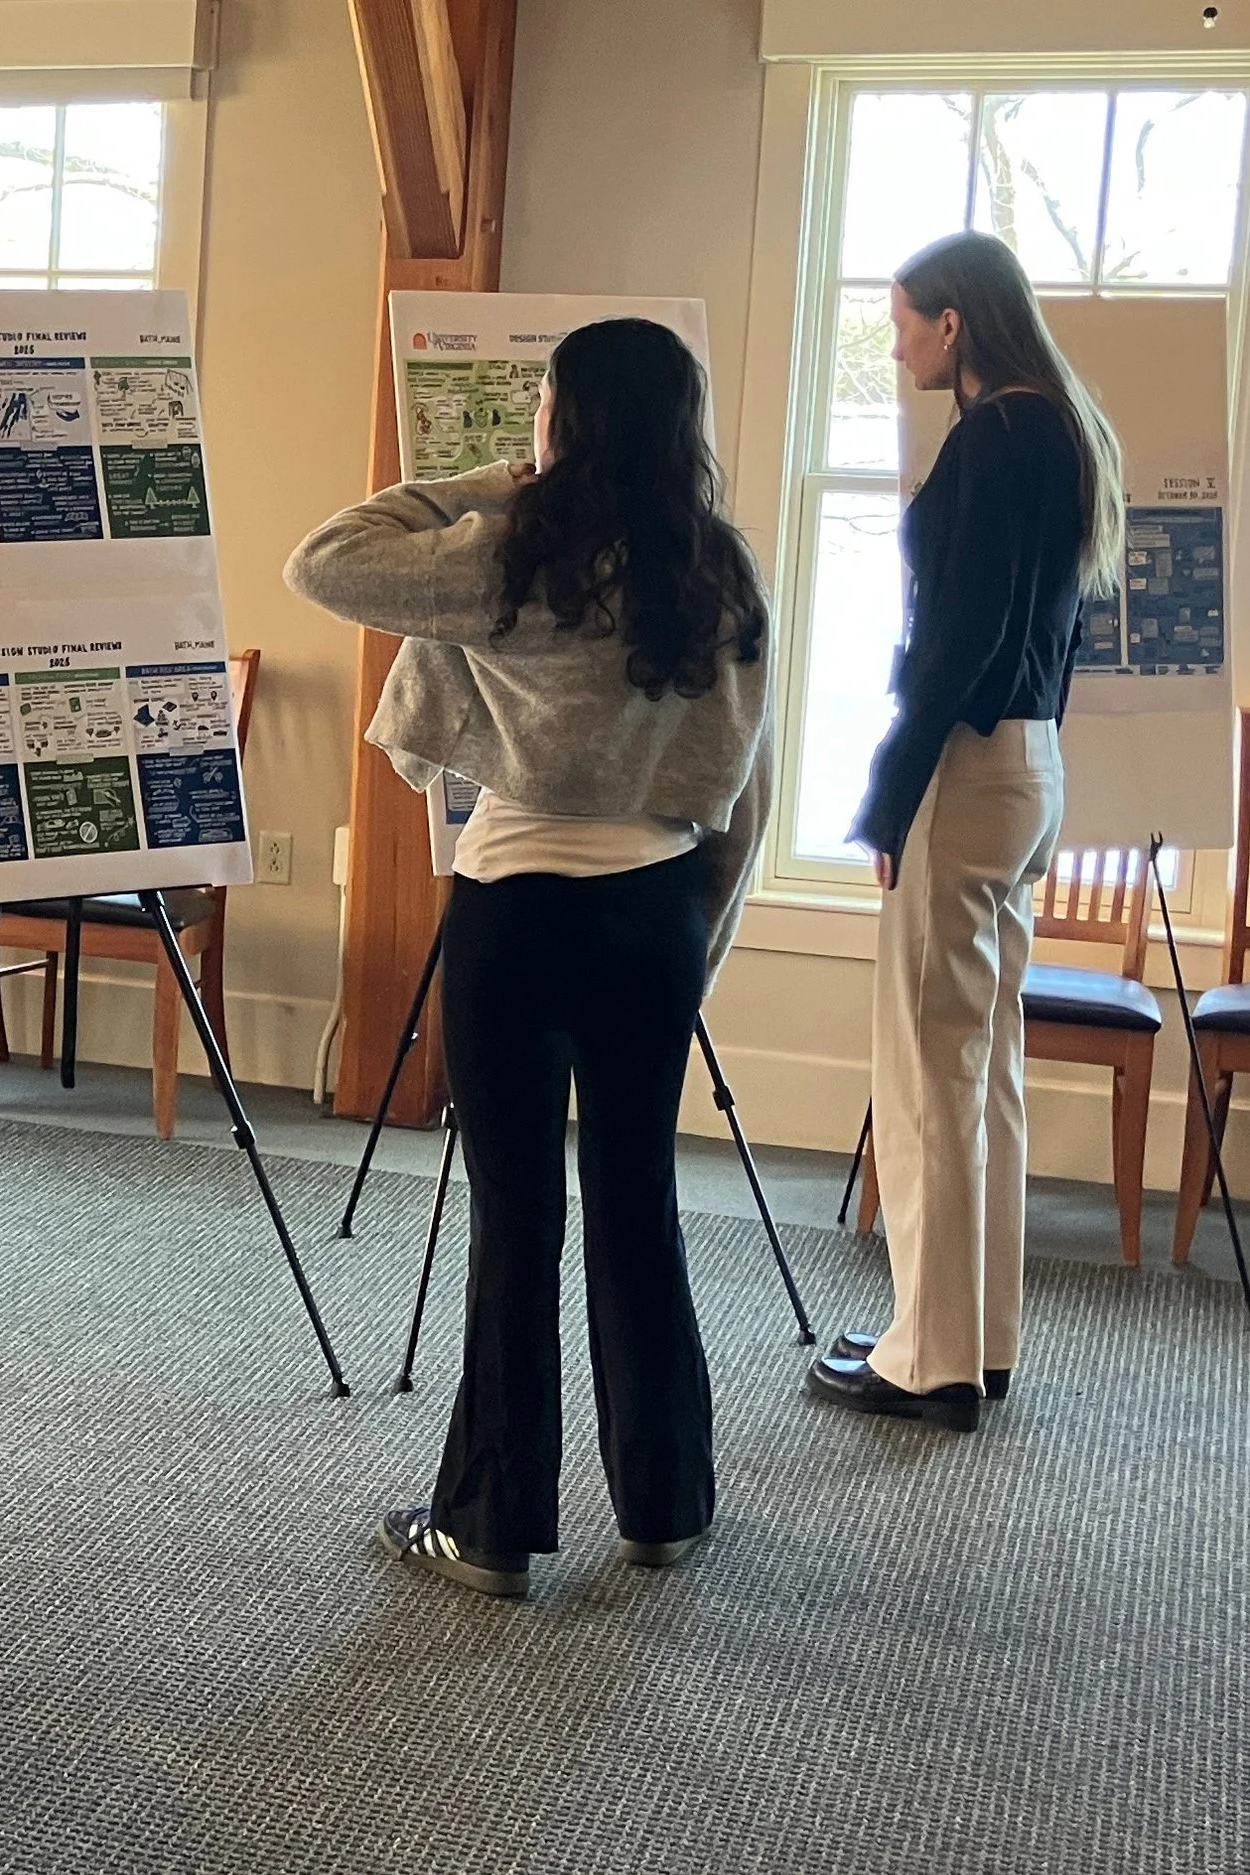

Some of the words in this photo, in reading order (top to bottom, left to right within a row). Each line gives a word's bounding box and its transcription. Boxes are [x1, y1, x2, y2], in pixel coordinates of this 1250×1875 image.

[26, 331, 52, 341] FINAL
[54, 331, 87, 341] REVIEWS
[509, 334, 537, 343] DESIGN
[14, 344, 35, 355] 2025
[1163, 477, 1200, 489] SESSION
[27, 645, 59, 656] STUDIO
[61, 643, 88, 654] FINAL
[90, 641, 122, 652] REVIEWS
[49, 657, 71, 668] 2025
